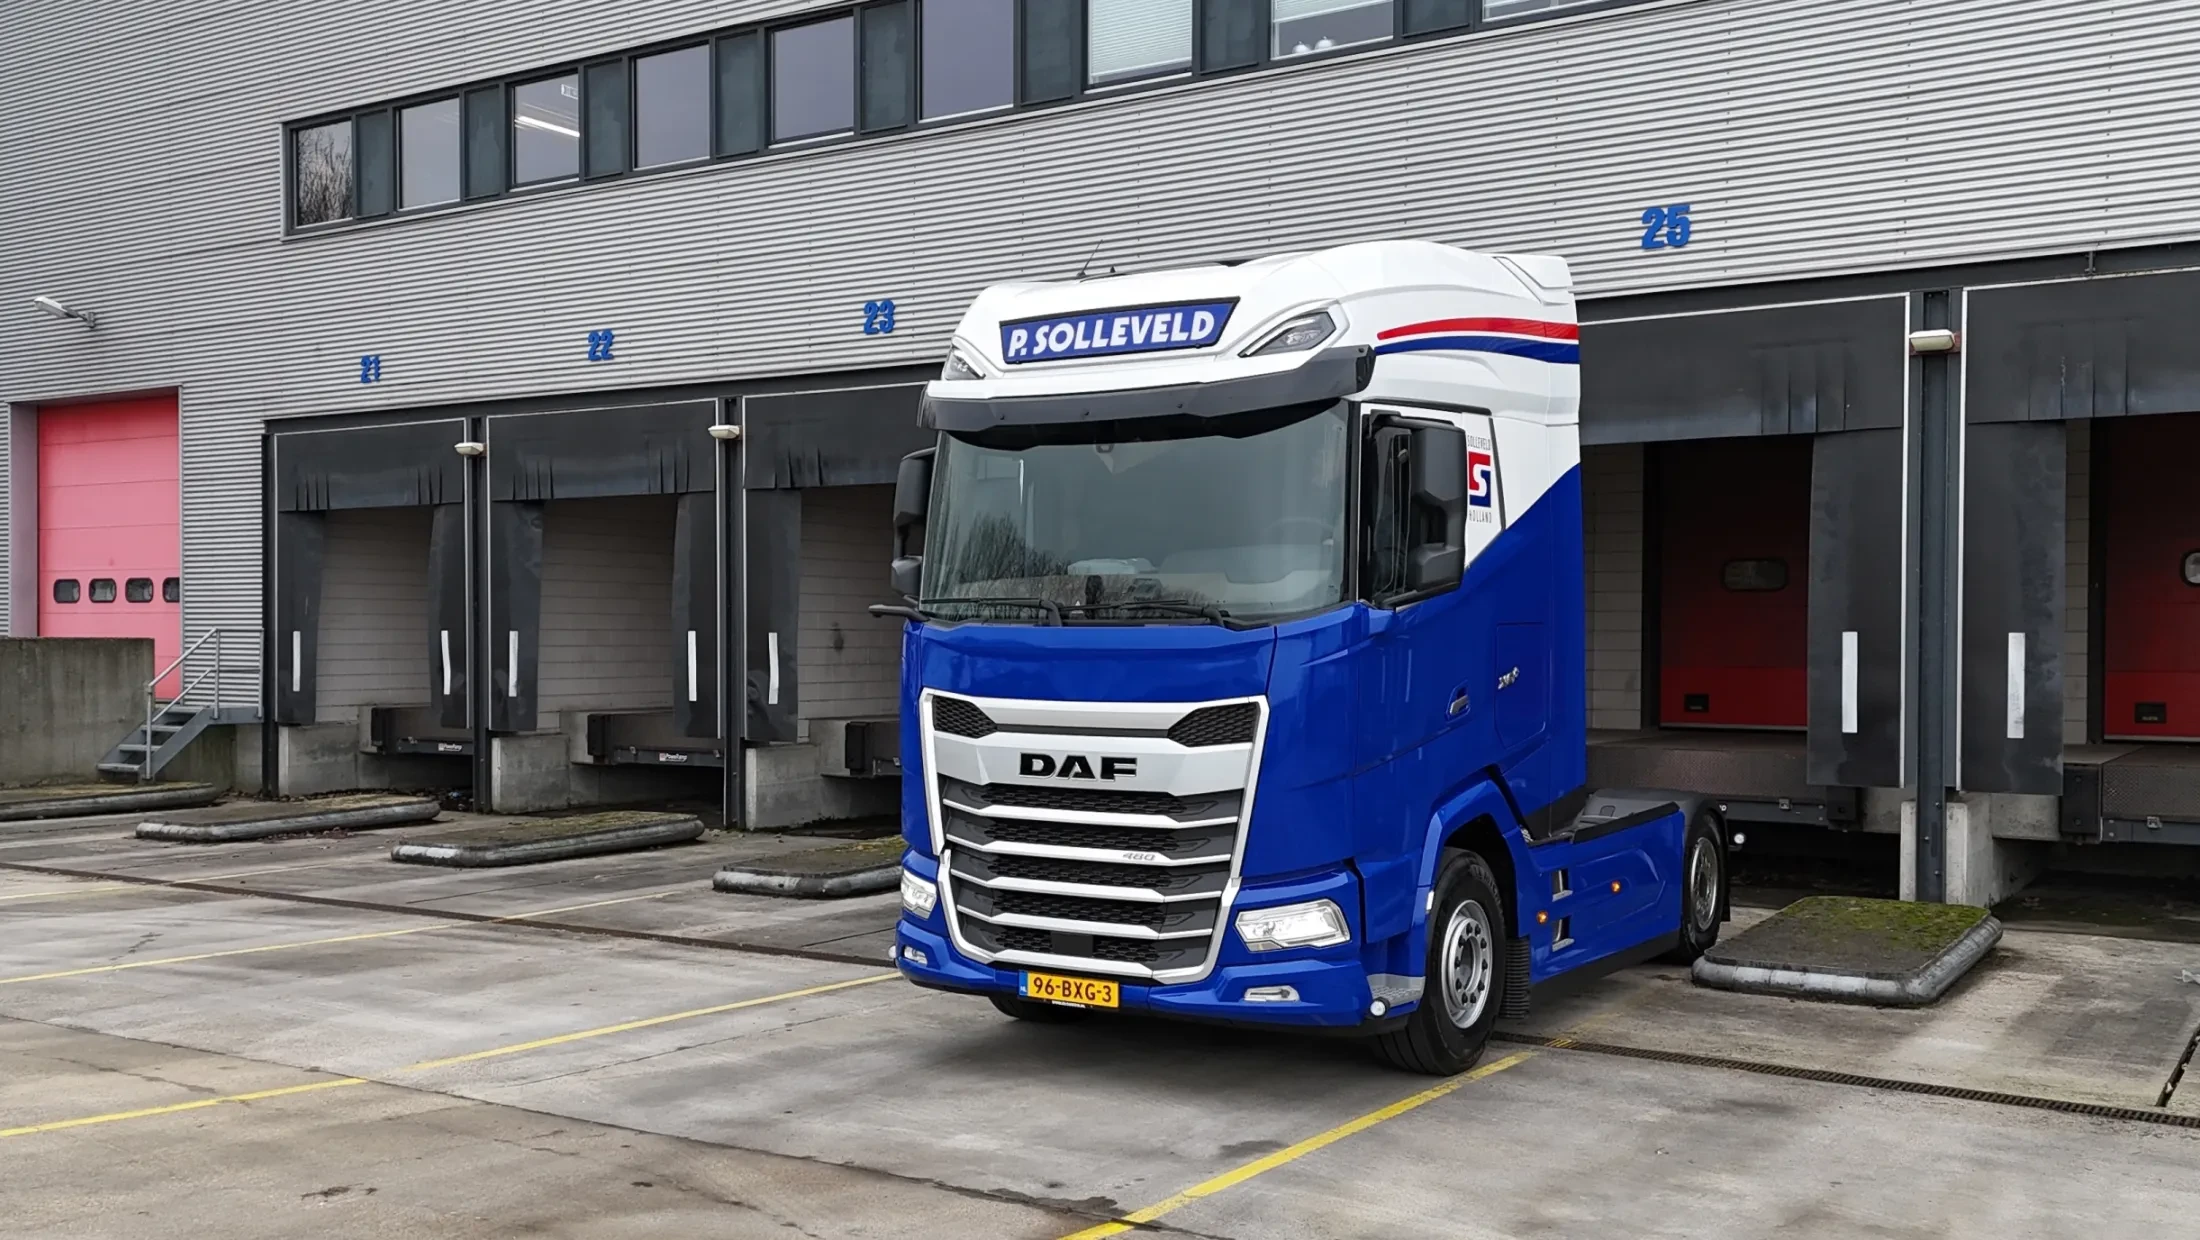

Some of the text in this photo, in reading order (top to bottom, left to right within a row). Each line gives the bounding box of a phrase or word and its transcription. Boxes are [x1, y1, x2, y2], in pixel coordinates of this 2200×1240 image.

[1641, 204, 1692, 250] 25
[864, 299, 895, 335] 23
[587, 329, 615, 361] 22
[1007, 310, 1215, 357] P. SOLLEVELD
[360, 354, 381, 384] 21
[1469, 510, 1492, 523] HOLLAND
[1019, 752, 1137, 782] DAF
[1123, 852, 1156, 862] 480
[1033, 976, 1112, 1003] 96-BXG-3
